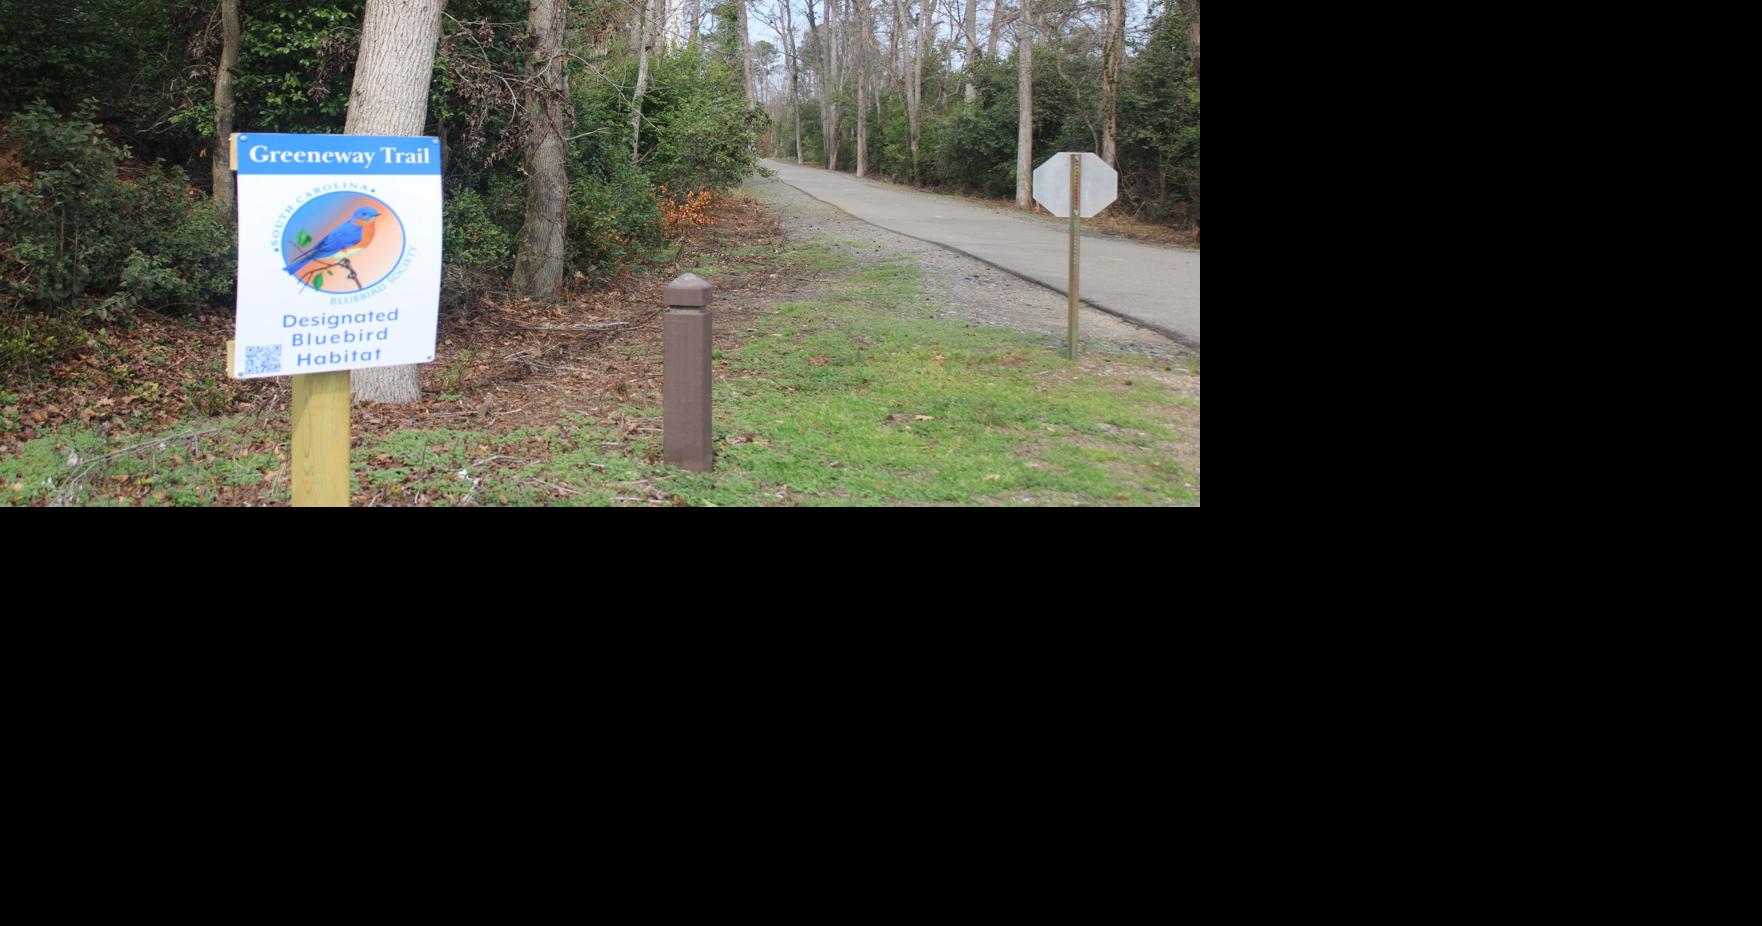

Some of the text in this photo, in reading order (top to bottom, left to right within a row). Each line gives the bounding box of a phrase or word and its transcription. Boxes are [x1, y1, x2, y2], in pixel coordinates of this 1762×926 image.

[249, 145, 430, 168] Greeneway Trail
[271, 181, 368, 247] SOUTH CAROLINA
[330, 245, 416, 305] BLUEBIRD SOCIETY
[283, 308, 399, 329] Designated
[292, 328, 388, 347] Bluebird
[297, 349, 382, 367] Habitat
